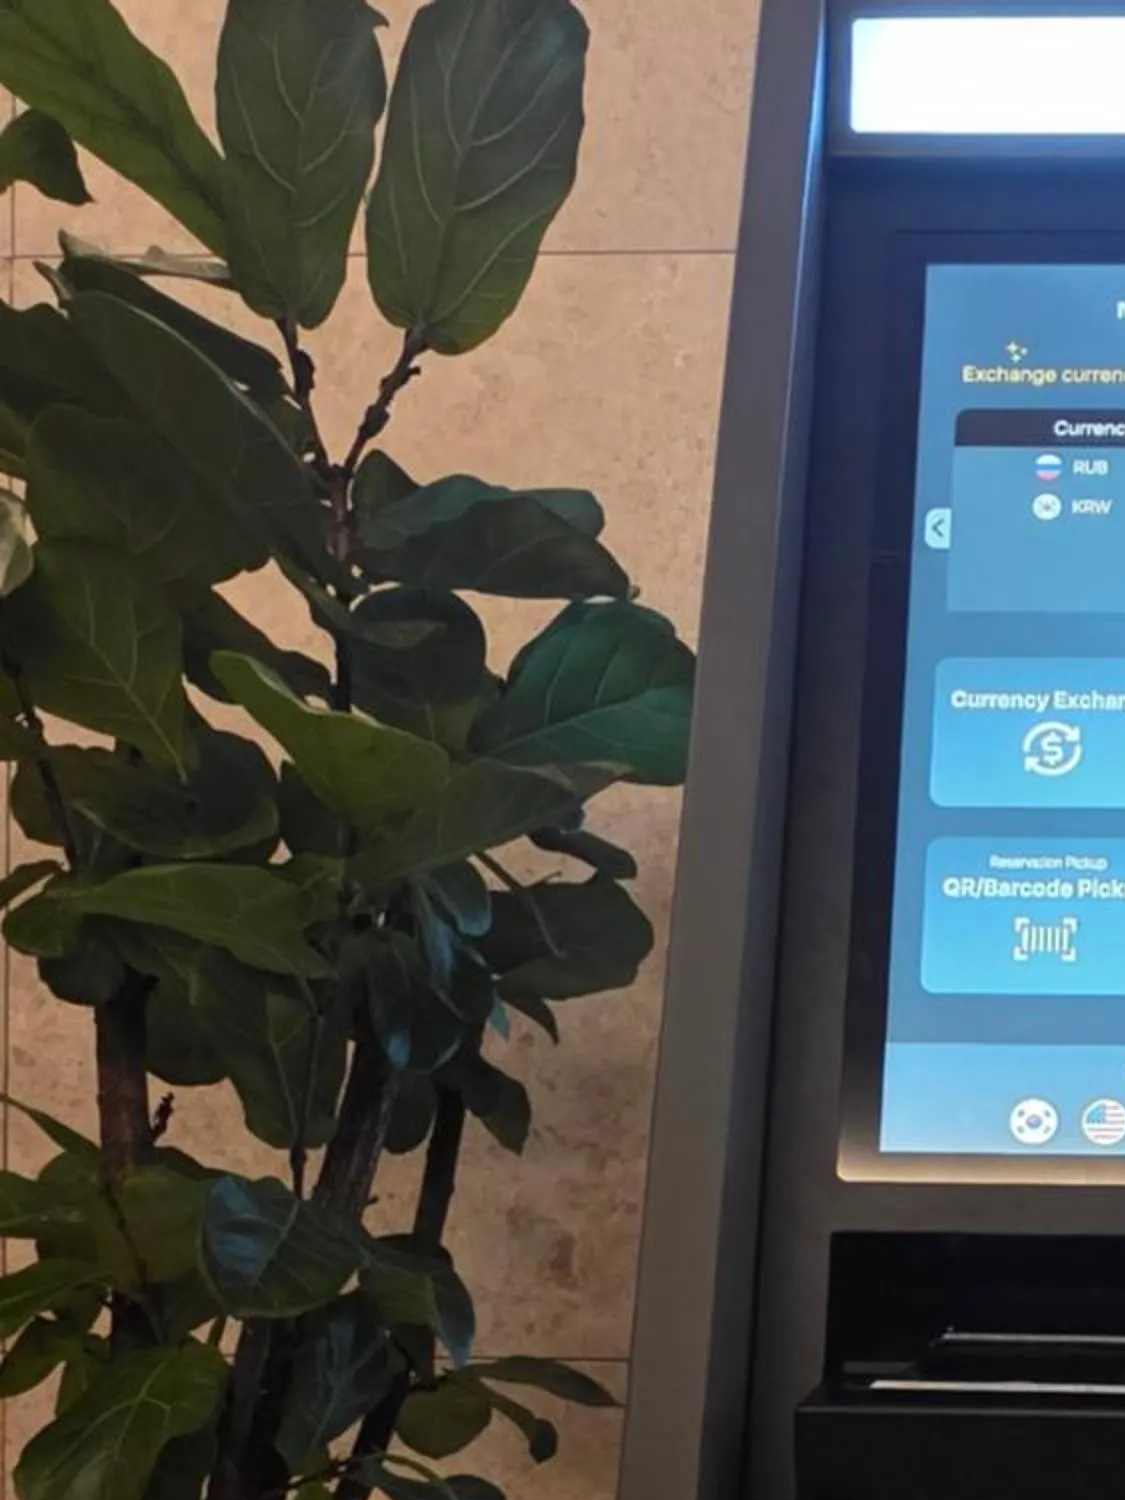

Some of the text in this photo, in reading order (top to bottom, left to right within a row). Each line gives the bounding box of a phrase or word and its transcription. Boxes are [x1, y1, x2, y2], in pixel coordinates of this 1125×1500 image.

[962, 365, 1057, 386] Exchange
[1072, 459, 1109, 476] RUB
[1070, 499, 1113, 516] KRW
[950, 688, 1051, 714] Currency
[989, 855, 1108, 872] Reservation Pickup
[942, 878, 1073, 900] QR/Barcode
